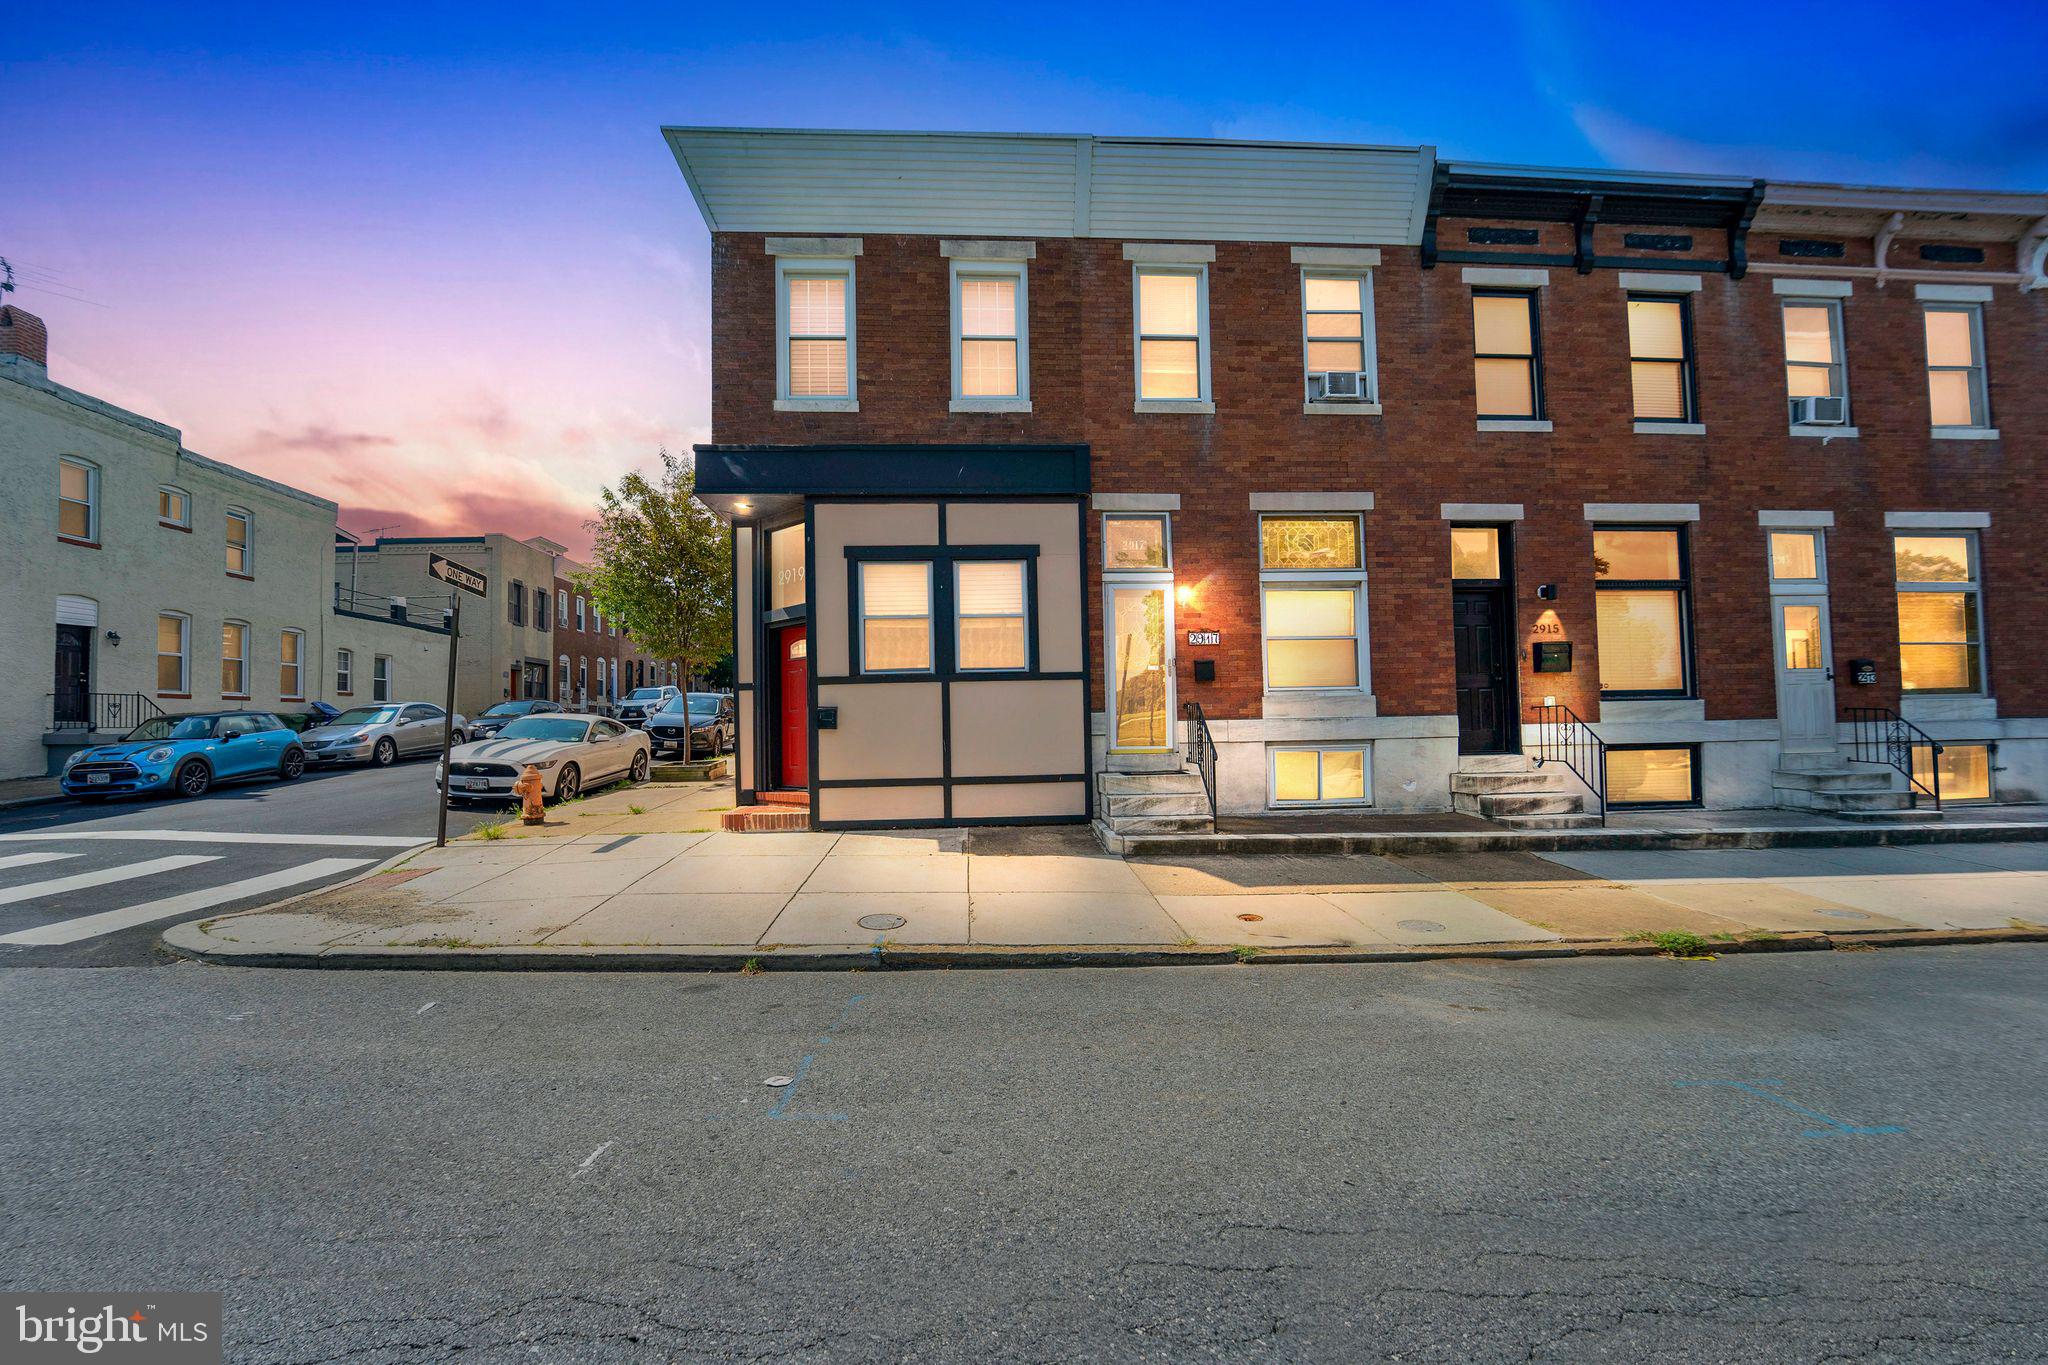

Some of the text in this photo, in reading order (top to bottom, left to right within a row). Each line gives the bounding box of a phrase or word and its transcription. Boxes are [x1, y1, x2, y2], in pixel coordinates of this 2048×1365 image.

[447, 567, 482, 589] ONE WAY
[778, 566, 805, 586] 2919
[1532, 623, 1560, 634] 2915
[1189, 633, 1219, 645] 2917
